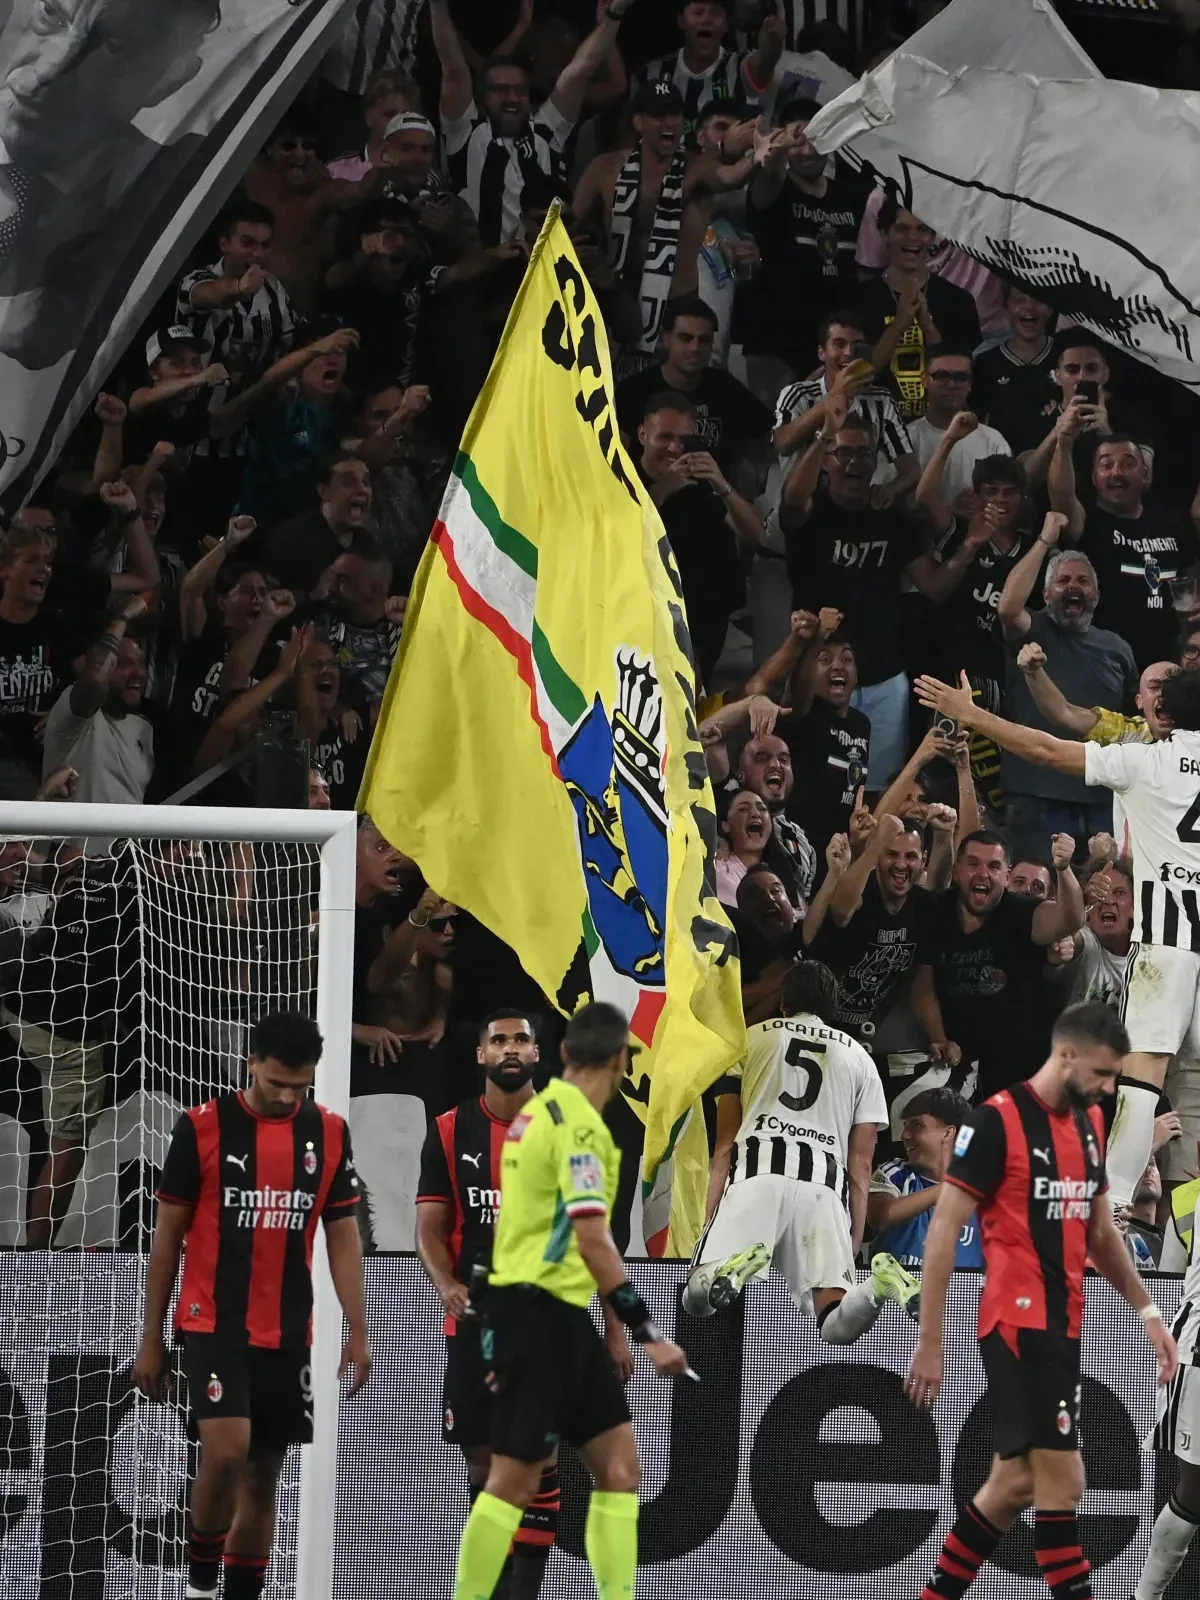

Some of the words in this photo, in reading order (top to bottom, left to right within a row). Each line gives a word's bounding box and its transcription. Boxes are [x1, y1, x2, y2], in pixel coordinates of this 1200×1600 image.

[822, 264, 839, 276] NOI
[830, 539, 889, 568] 1977
[973, 582, 1003, 608] Je
[1147, 595, 1163, 609] NOI
[67, 926, 84, 935] 1874
[762, 1020, 852, 1048] LOCATELLI
[778, 1038, 827, 1111] 5
[767, 1116, 835, 1146] Cygames
[223, 1184, 317, 1209] Emirates
[237, 1210, 260, 1229] FLY
